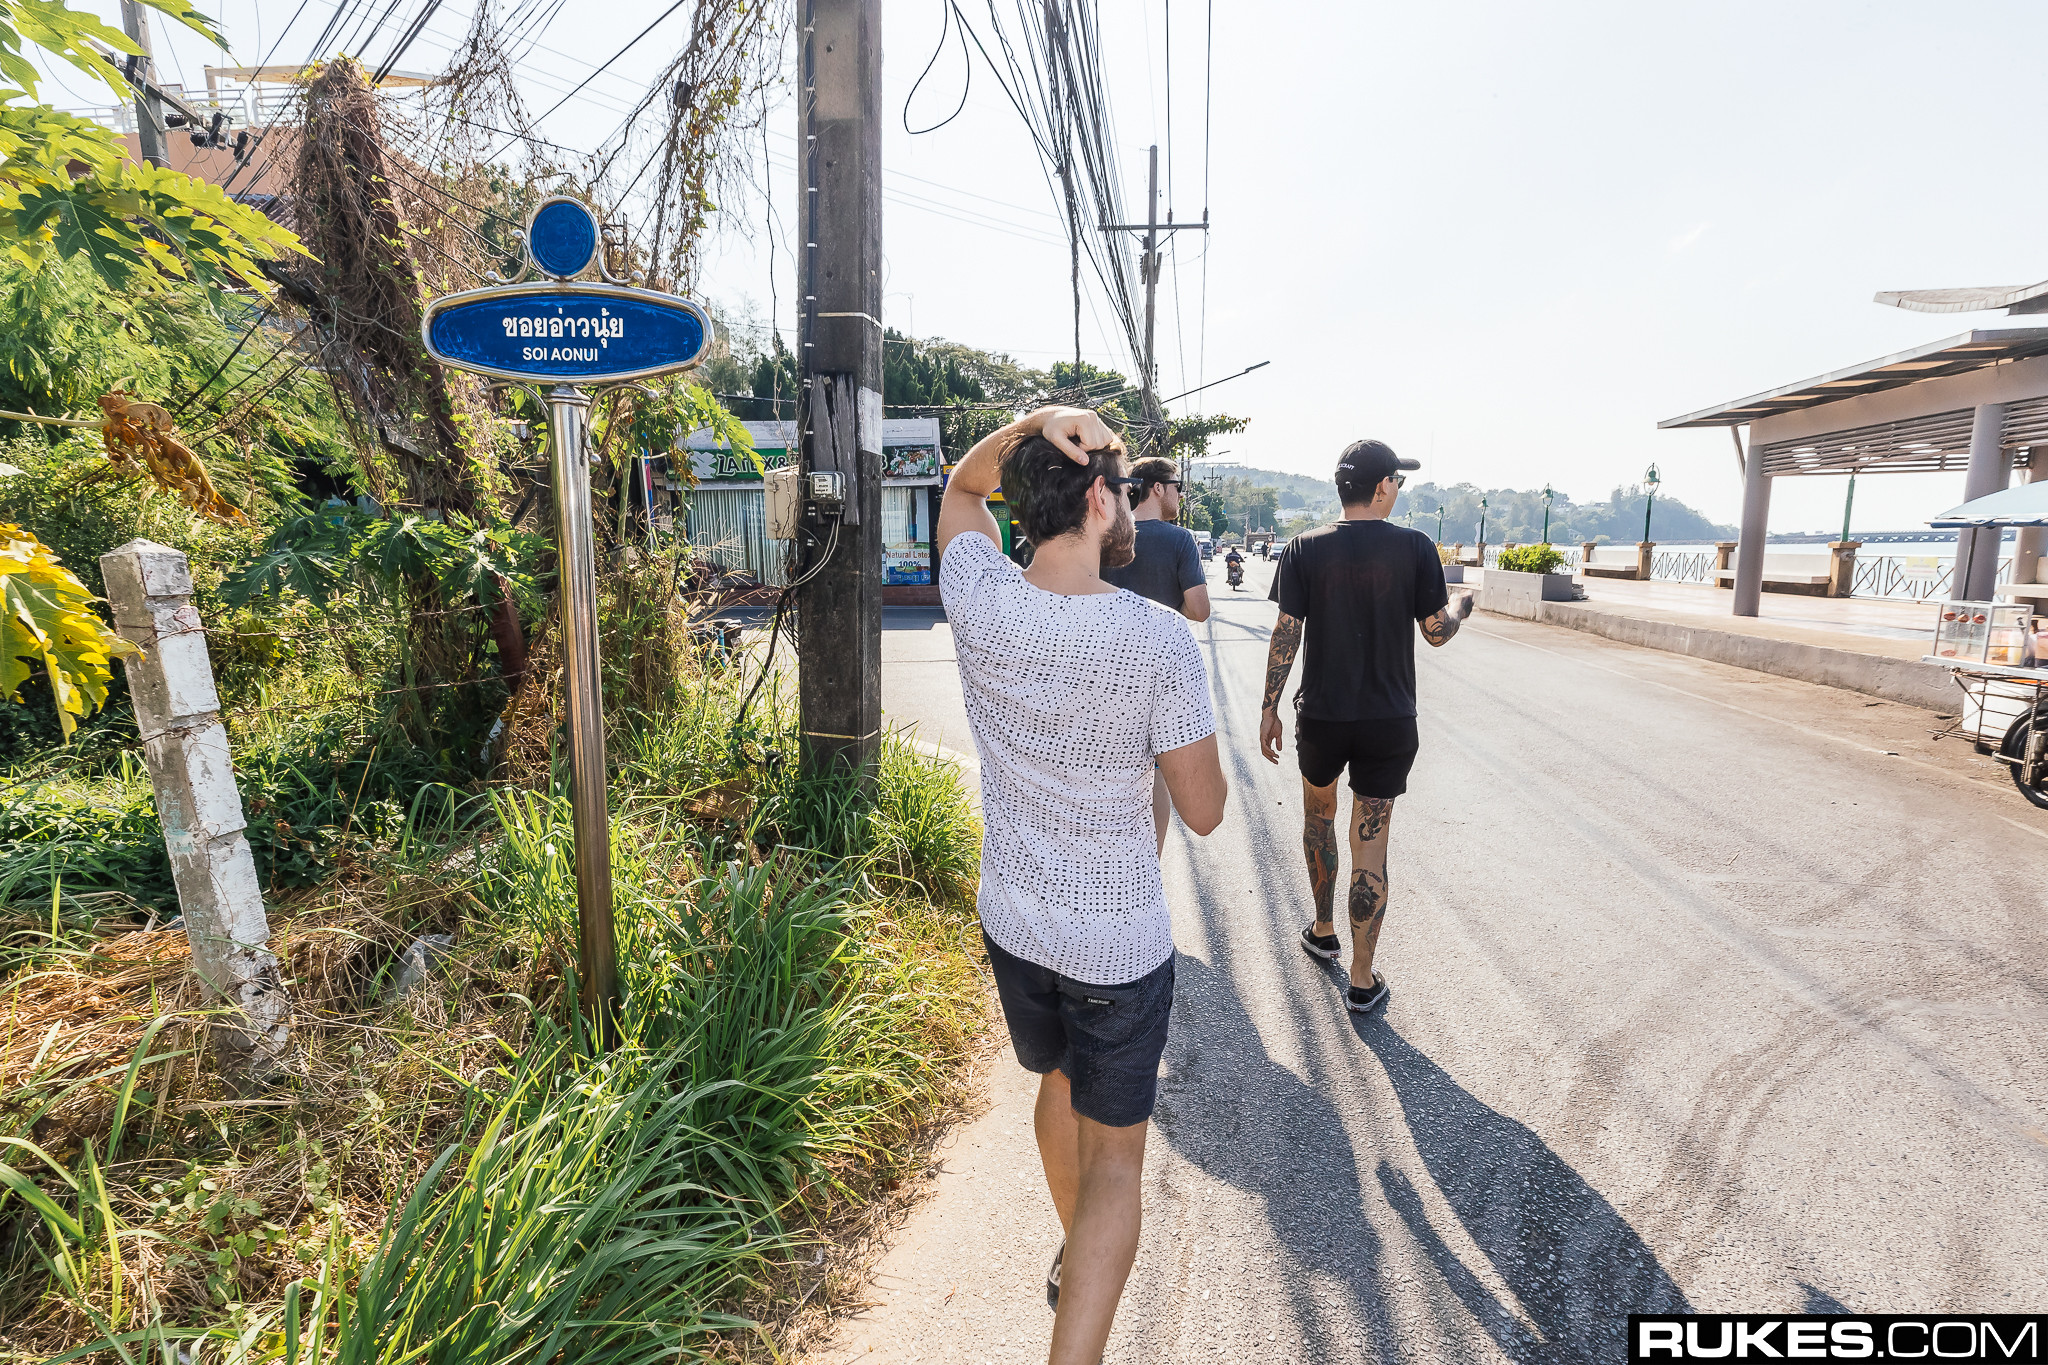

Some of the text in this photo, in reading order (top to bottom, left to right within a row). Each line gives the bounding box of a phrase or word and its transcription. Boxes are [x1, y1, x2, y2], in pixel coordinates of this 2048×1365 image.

[502, 307, 624, 348] ซอยอ่าวนุ้ย
[523, 347, 598, 362] SOI AONUI
